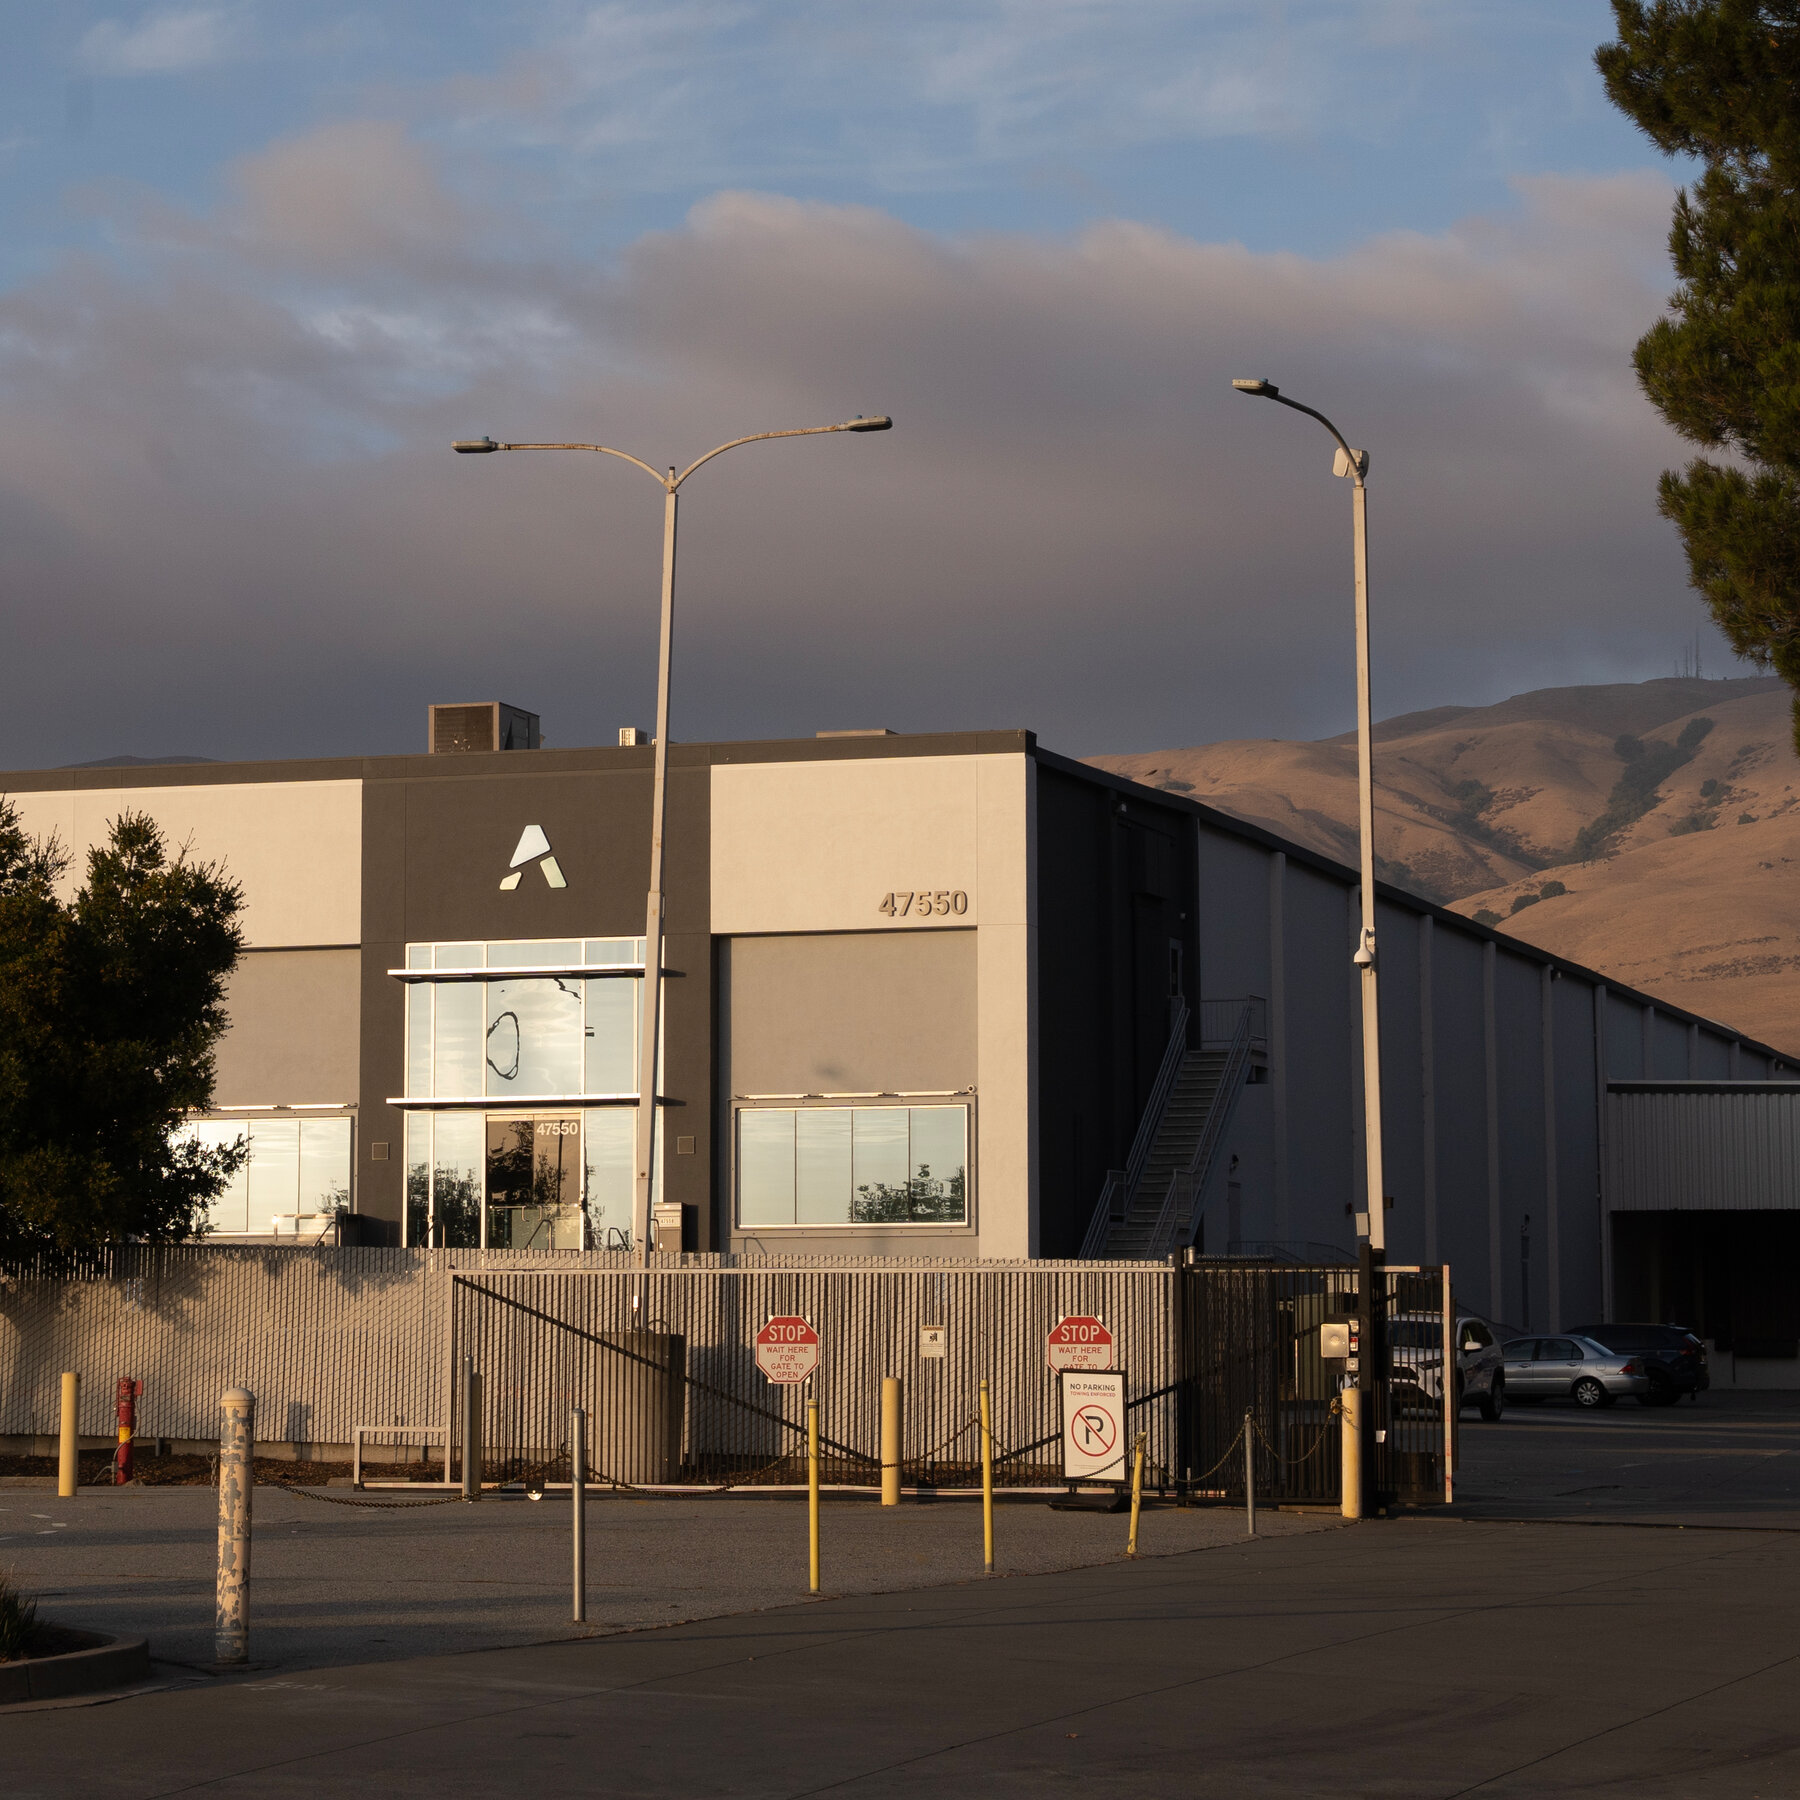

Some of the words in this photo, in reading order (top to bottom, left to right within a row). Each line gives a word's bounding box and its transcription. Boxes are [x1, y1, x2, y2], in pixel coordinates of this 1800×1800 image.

[879, 890, 968, 917] 47550
[537, 1122, 578, 1136] 47550
[769, 1325, 807, 1341] STOP
[1060, 1325, 1100, 1341] STOP
[1058, 1346, 1078, 1354] WAIT
[1080, 1346, 1102, 1354] HERE
